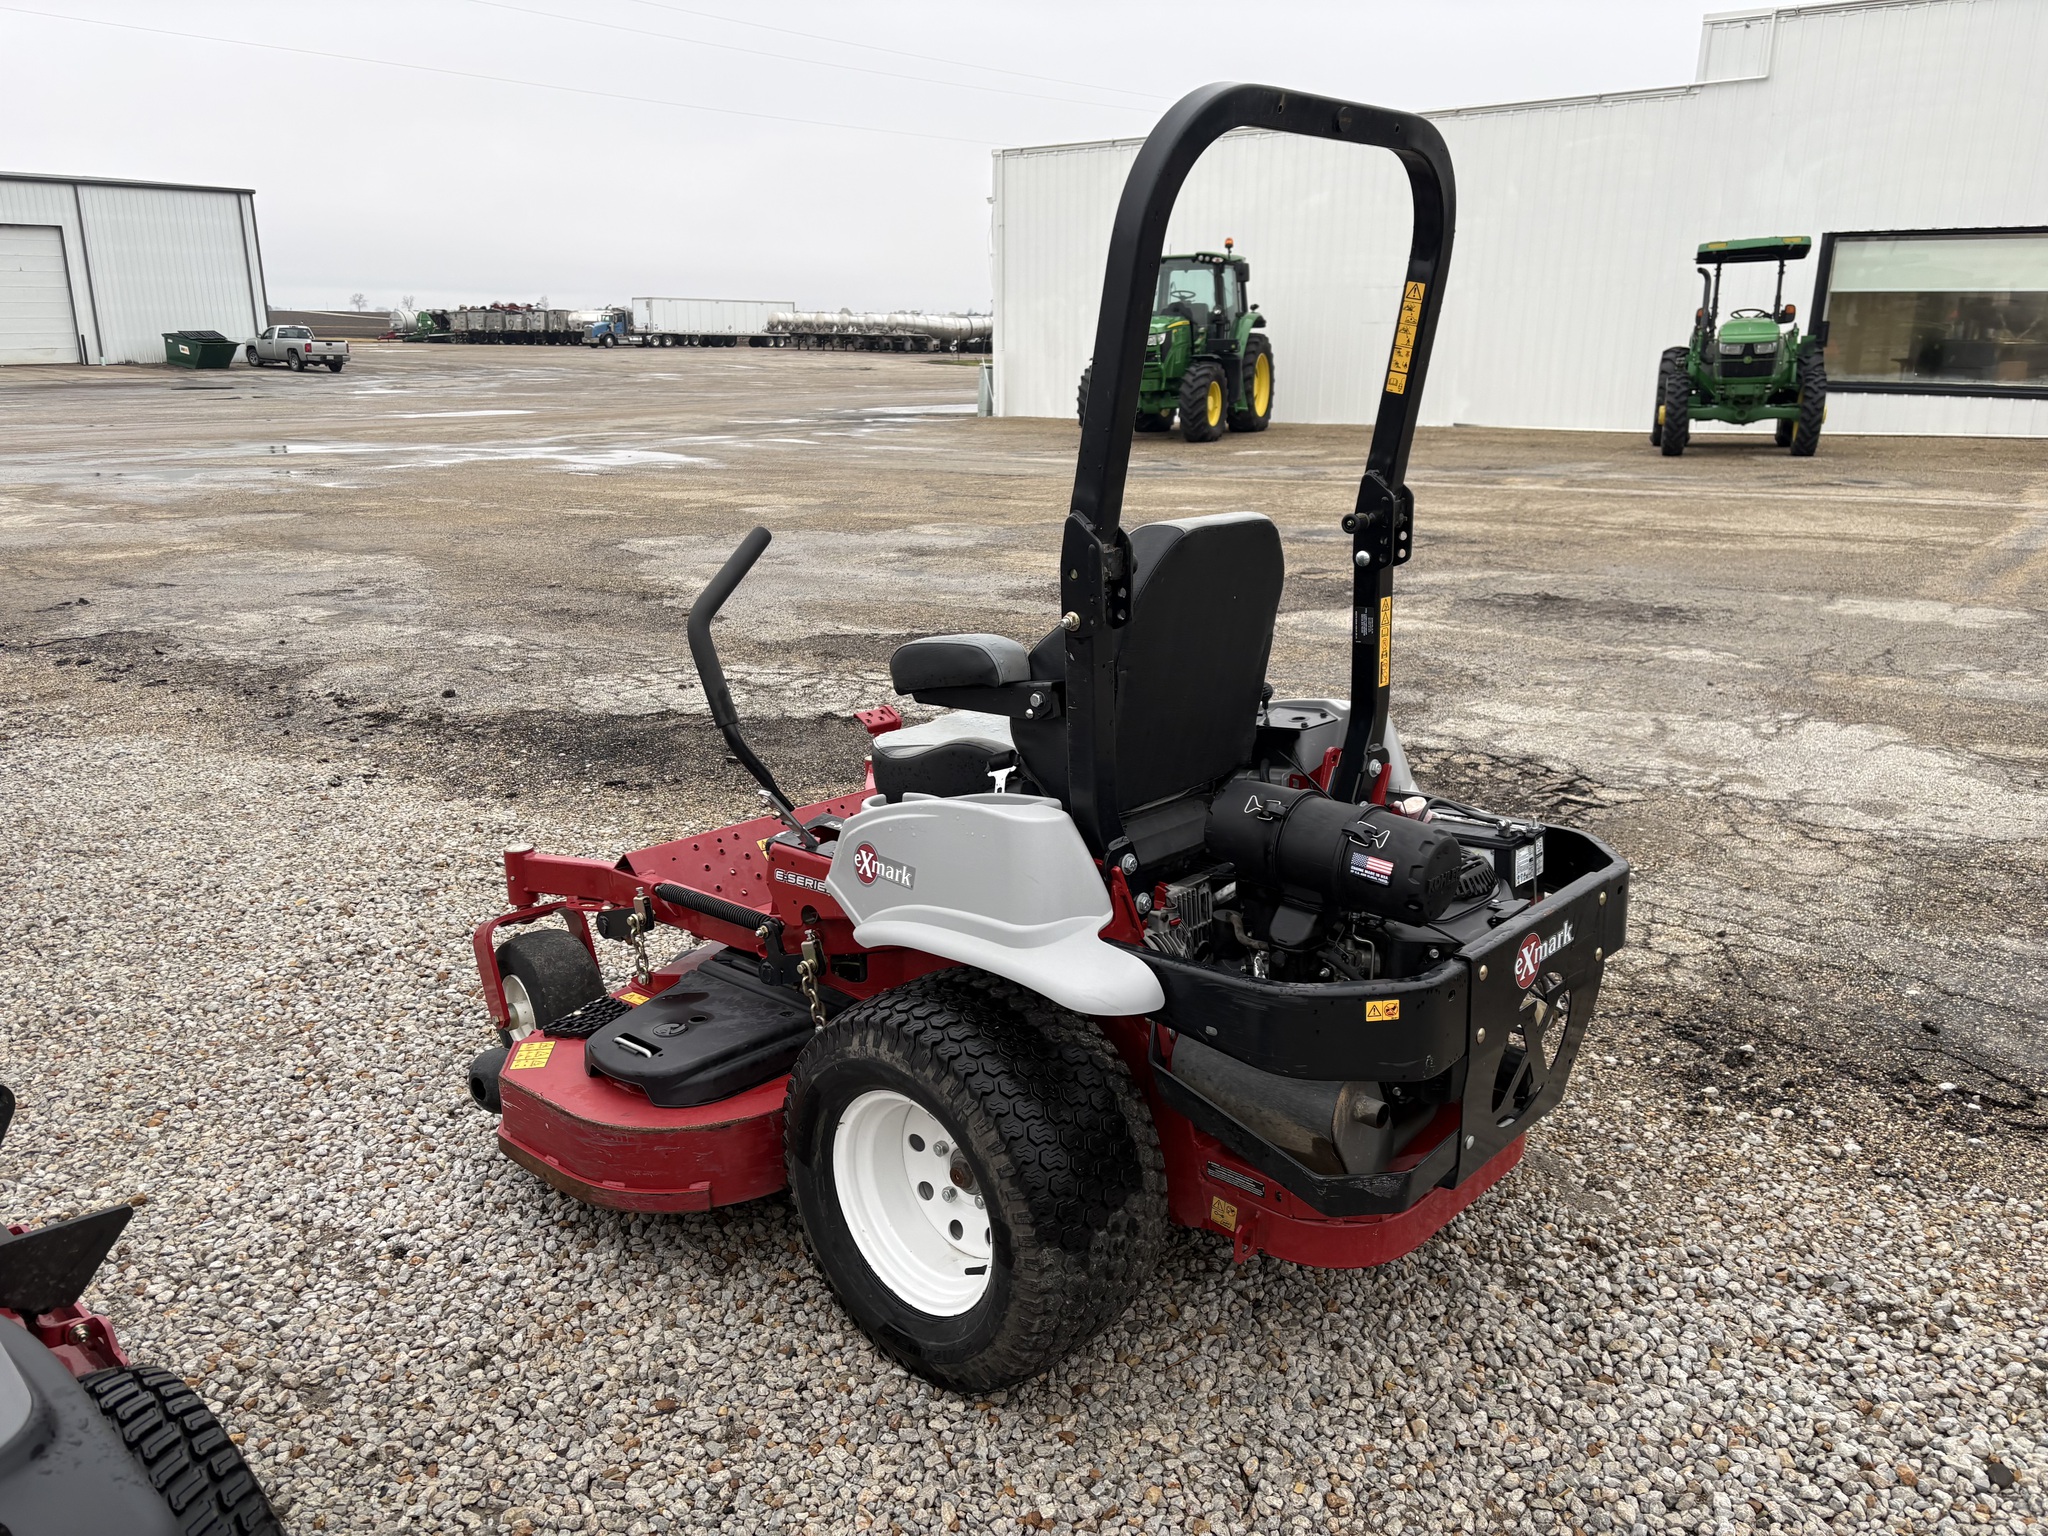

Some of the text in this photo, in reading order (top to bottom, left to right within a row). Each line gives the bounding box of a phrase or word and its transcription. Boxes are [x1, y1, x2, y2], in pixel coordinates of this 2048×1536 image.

[775, 869, 829, 893] E-SERIE
[854, 849, 912, 887] eXmark
[1514, 920, 1573, 982] eXmark
